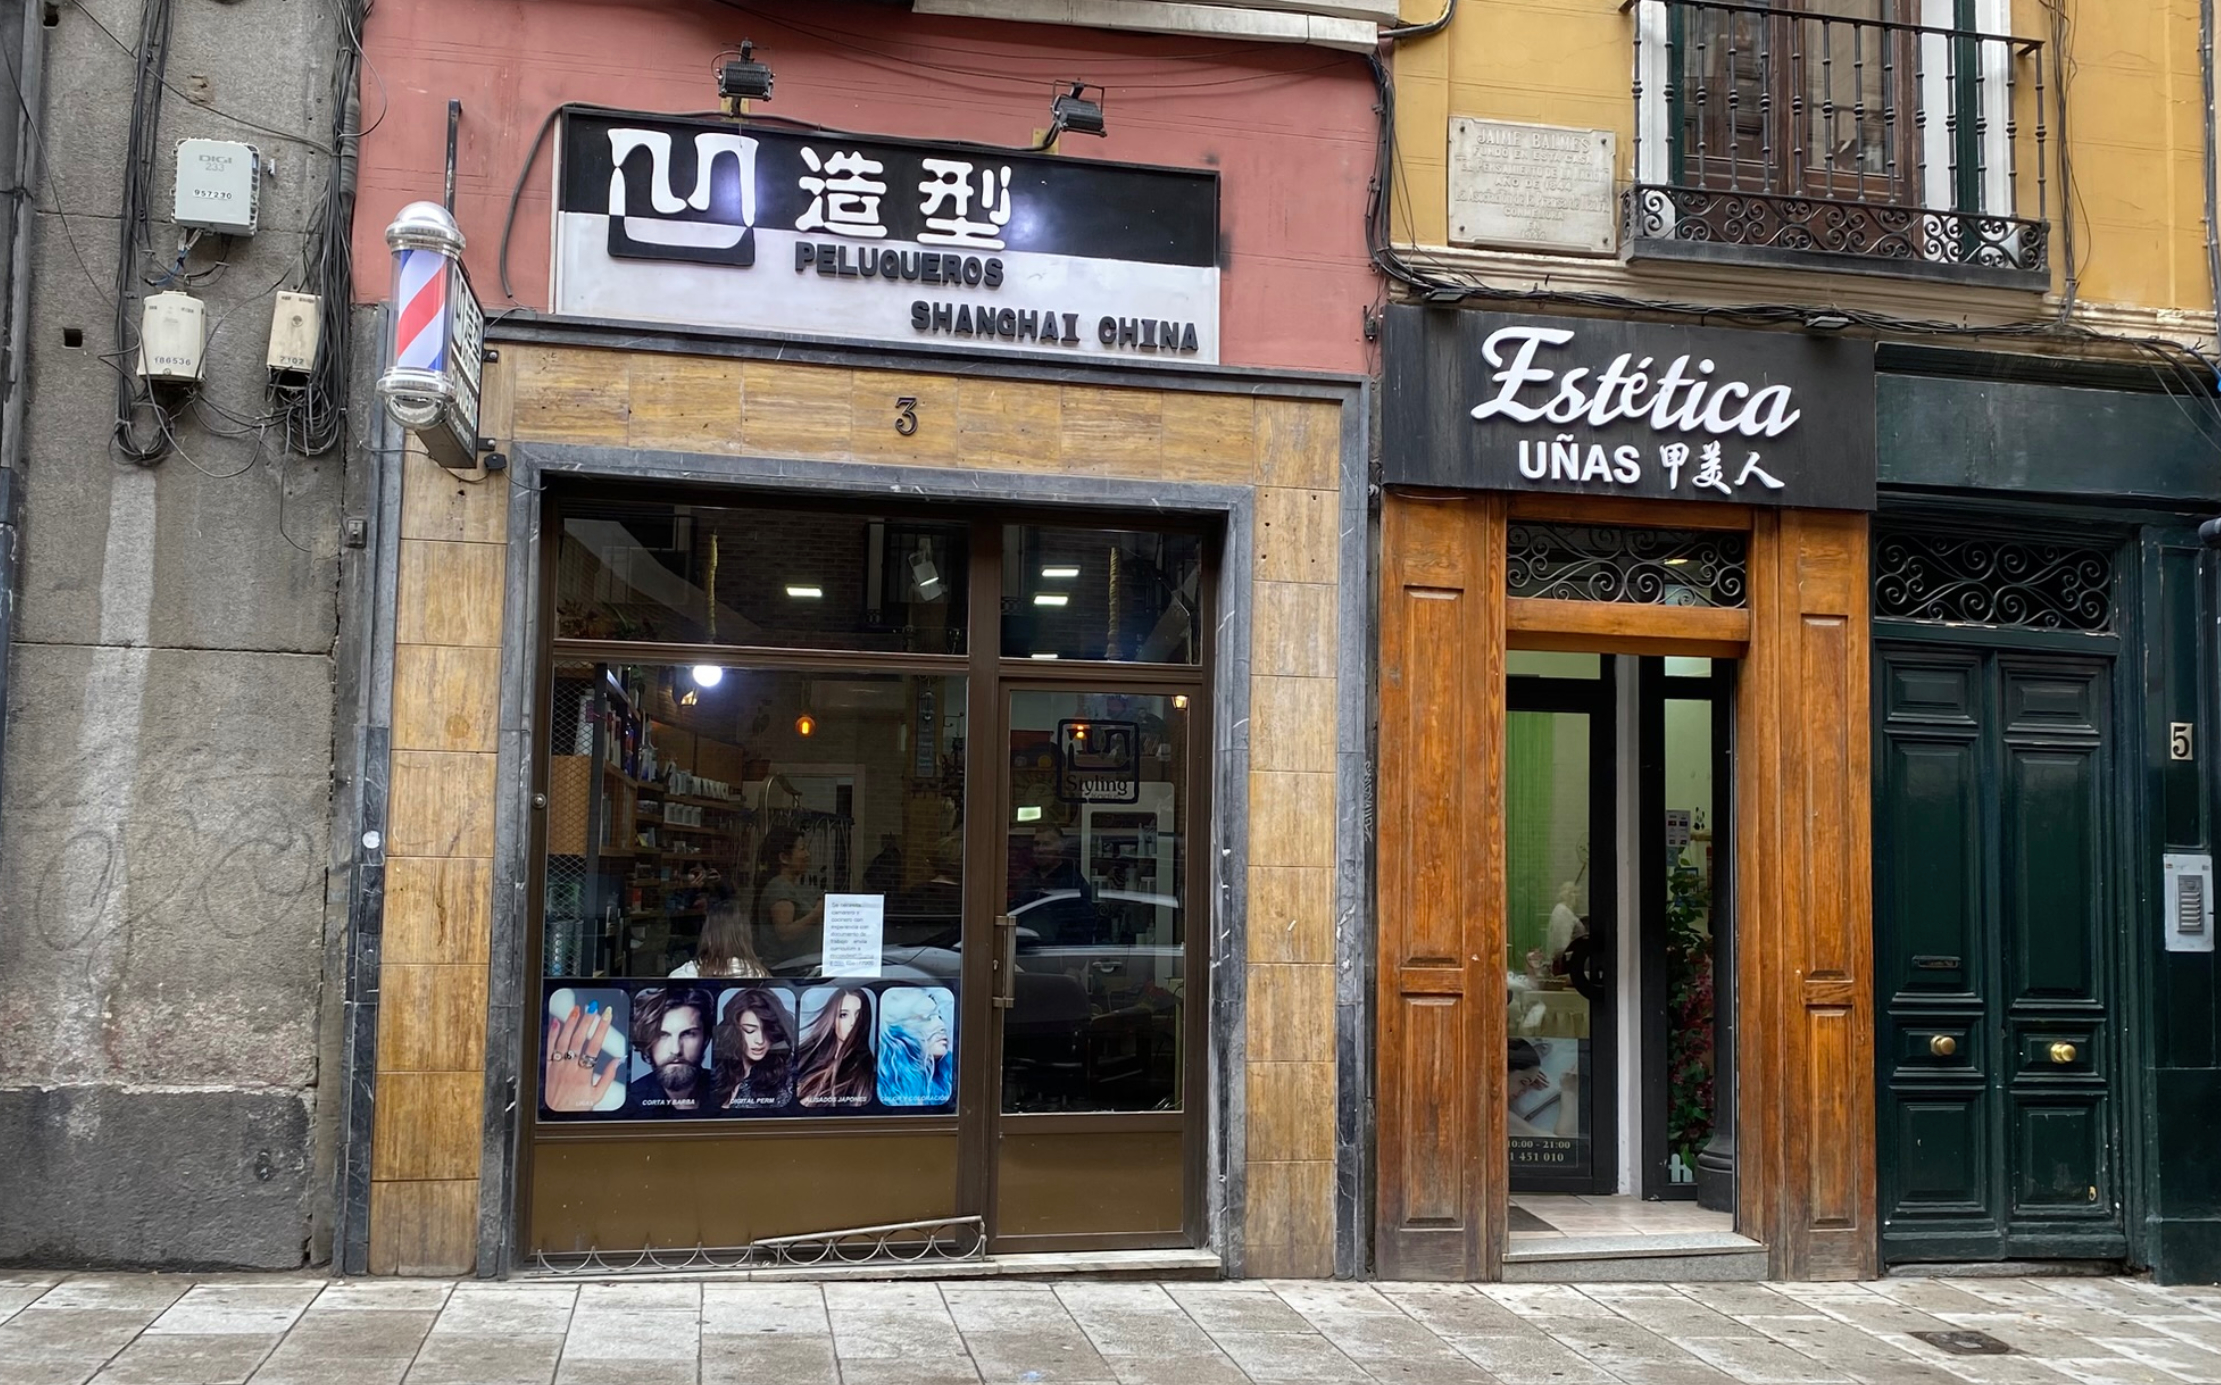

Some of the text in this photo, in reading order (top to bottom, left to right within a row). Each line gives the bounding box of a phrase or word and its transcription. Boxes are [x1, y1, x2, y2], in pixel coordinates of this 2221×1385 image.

[1477, 128, 1591, 154] JAIME BALMES
[199, 154, 233, 164] DIGI
[1533, 150, 1562, 164] ESTA
[1564, 154, 1594, 167] CASA
[795, 145, 1013, 251] 造型
[1525, 178, 1540, 190] DE
[795, 241, 1005, 288] PELUQUEROS
[910, 301, 1200, 352] SHANGHAI CHINA
[1470, 326, 1801, 439] Estética
[894, 396, 919, 437] 3
[1518, 433, 1641, 484] UÑAS
[2173, 726, 2190, 758] 5
[1065, 774, 1128, 796] Styling
[1519, 1152, 1539, 1161] 451
[1543, 1152, 1564, 1162] 010
[1542, 1141, 1571, 1149] 21:00
